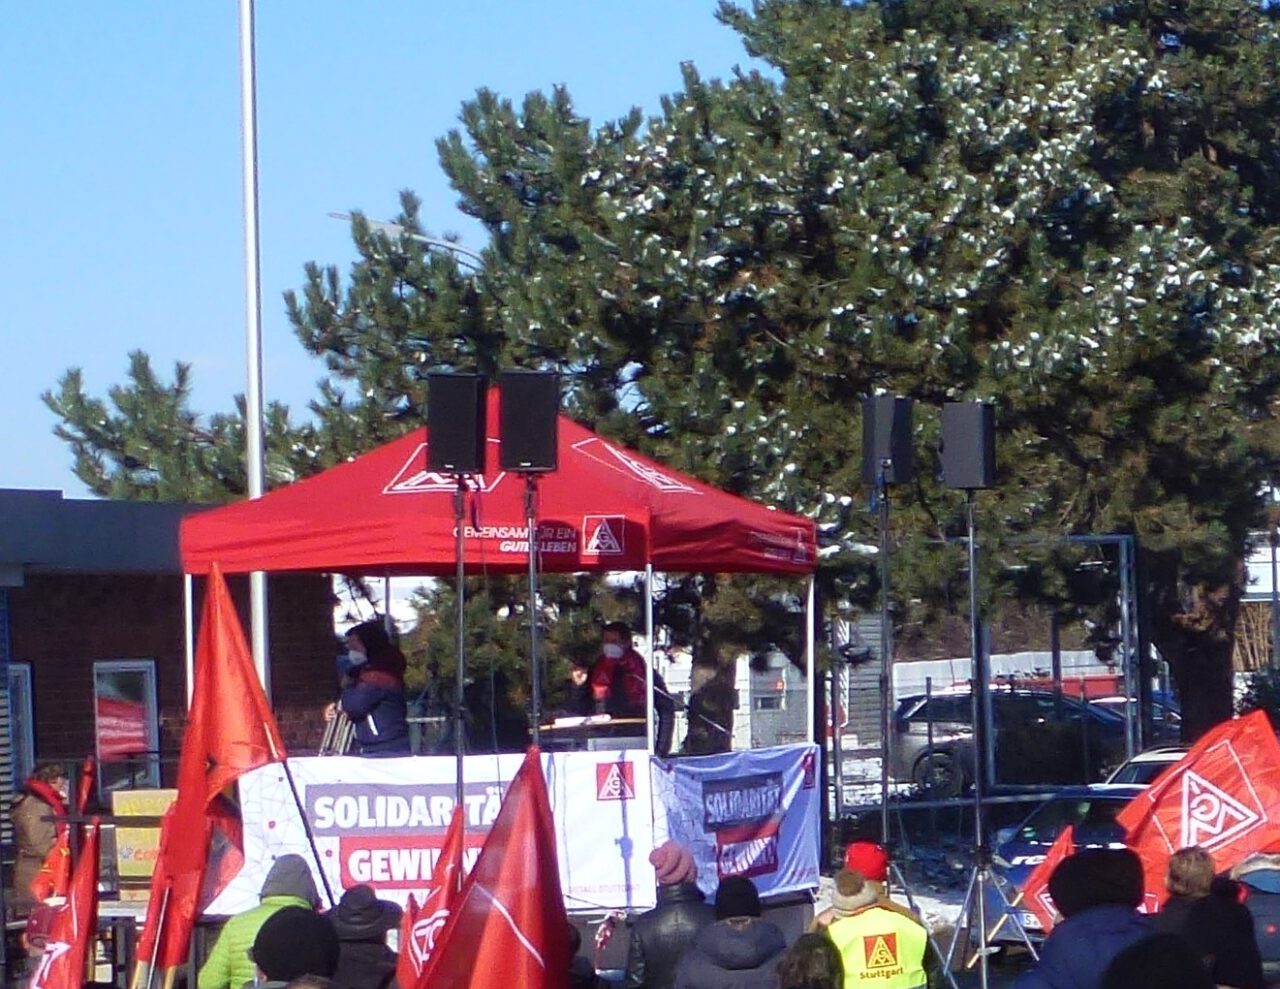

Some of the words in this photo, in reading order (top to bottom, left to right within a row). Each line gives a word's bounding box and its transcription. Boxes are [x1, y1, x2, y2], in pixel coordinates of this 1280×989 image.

[556, 526, 577, 539] EIN
[499, 541, 538, 552] GUTS
[541, 541, 577, 552] LEBEN
[313, 786, 504, 829] SOLIDARTÄ
[859, 967, 904, 979] Stuttgart
